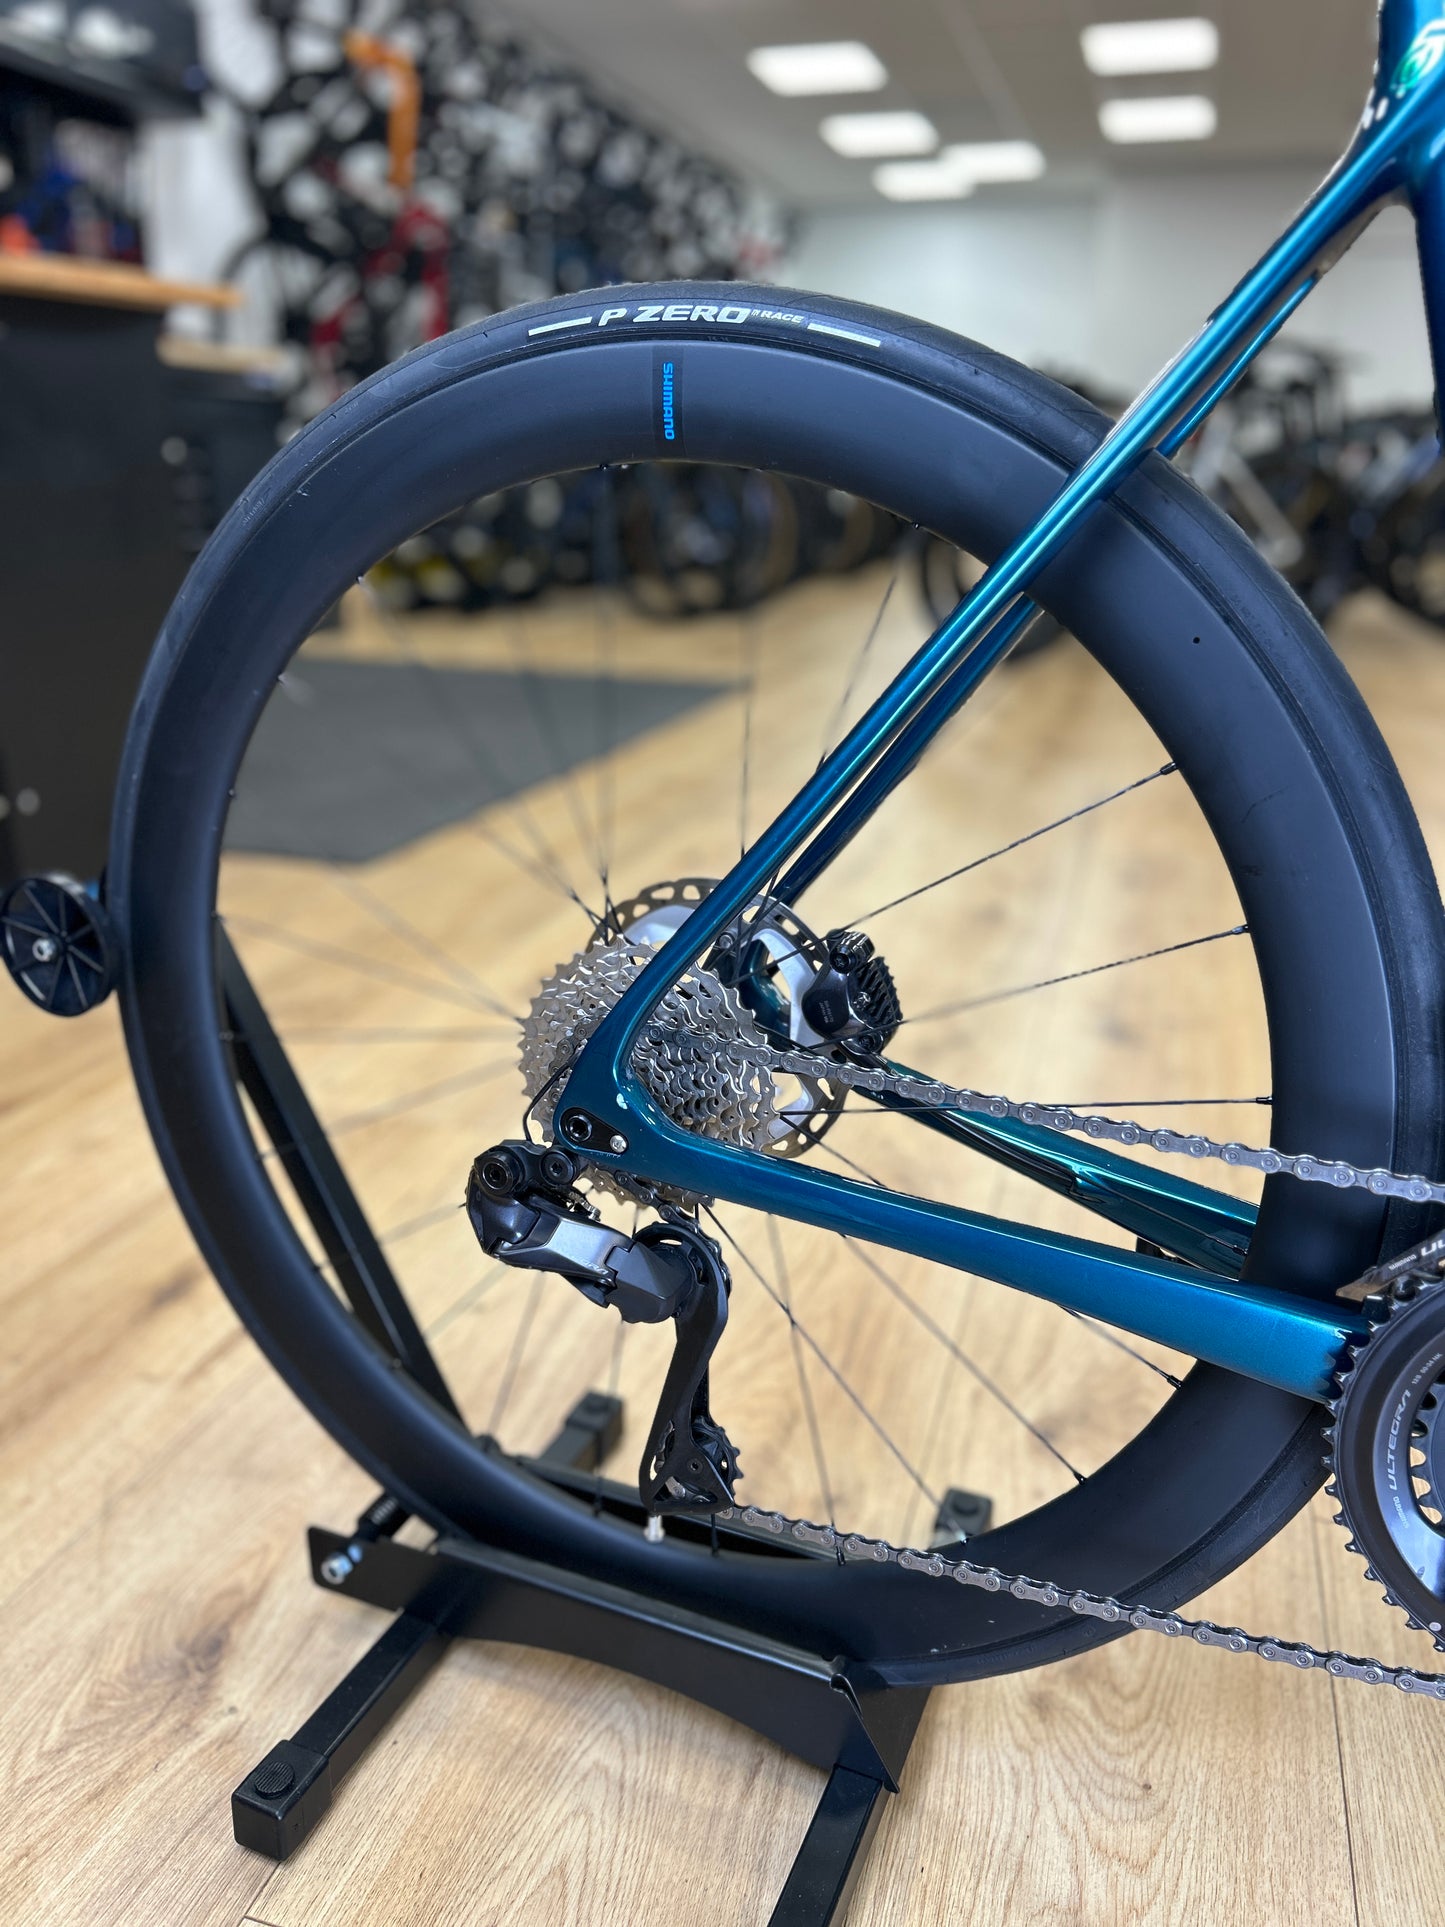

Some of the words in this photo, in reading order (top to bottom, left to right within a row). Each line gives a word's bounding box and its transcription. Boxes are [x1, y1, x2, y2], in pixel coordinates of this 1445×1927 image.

[598, 308, 628, 327] P
[760, 310, 805, 323] RACE
[663, 362, 675, 440] SHIMANO
[1387, 1389, 1411, 1491] ULTEGRA
